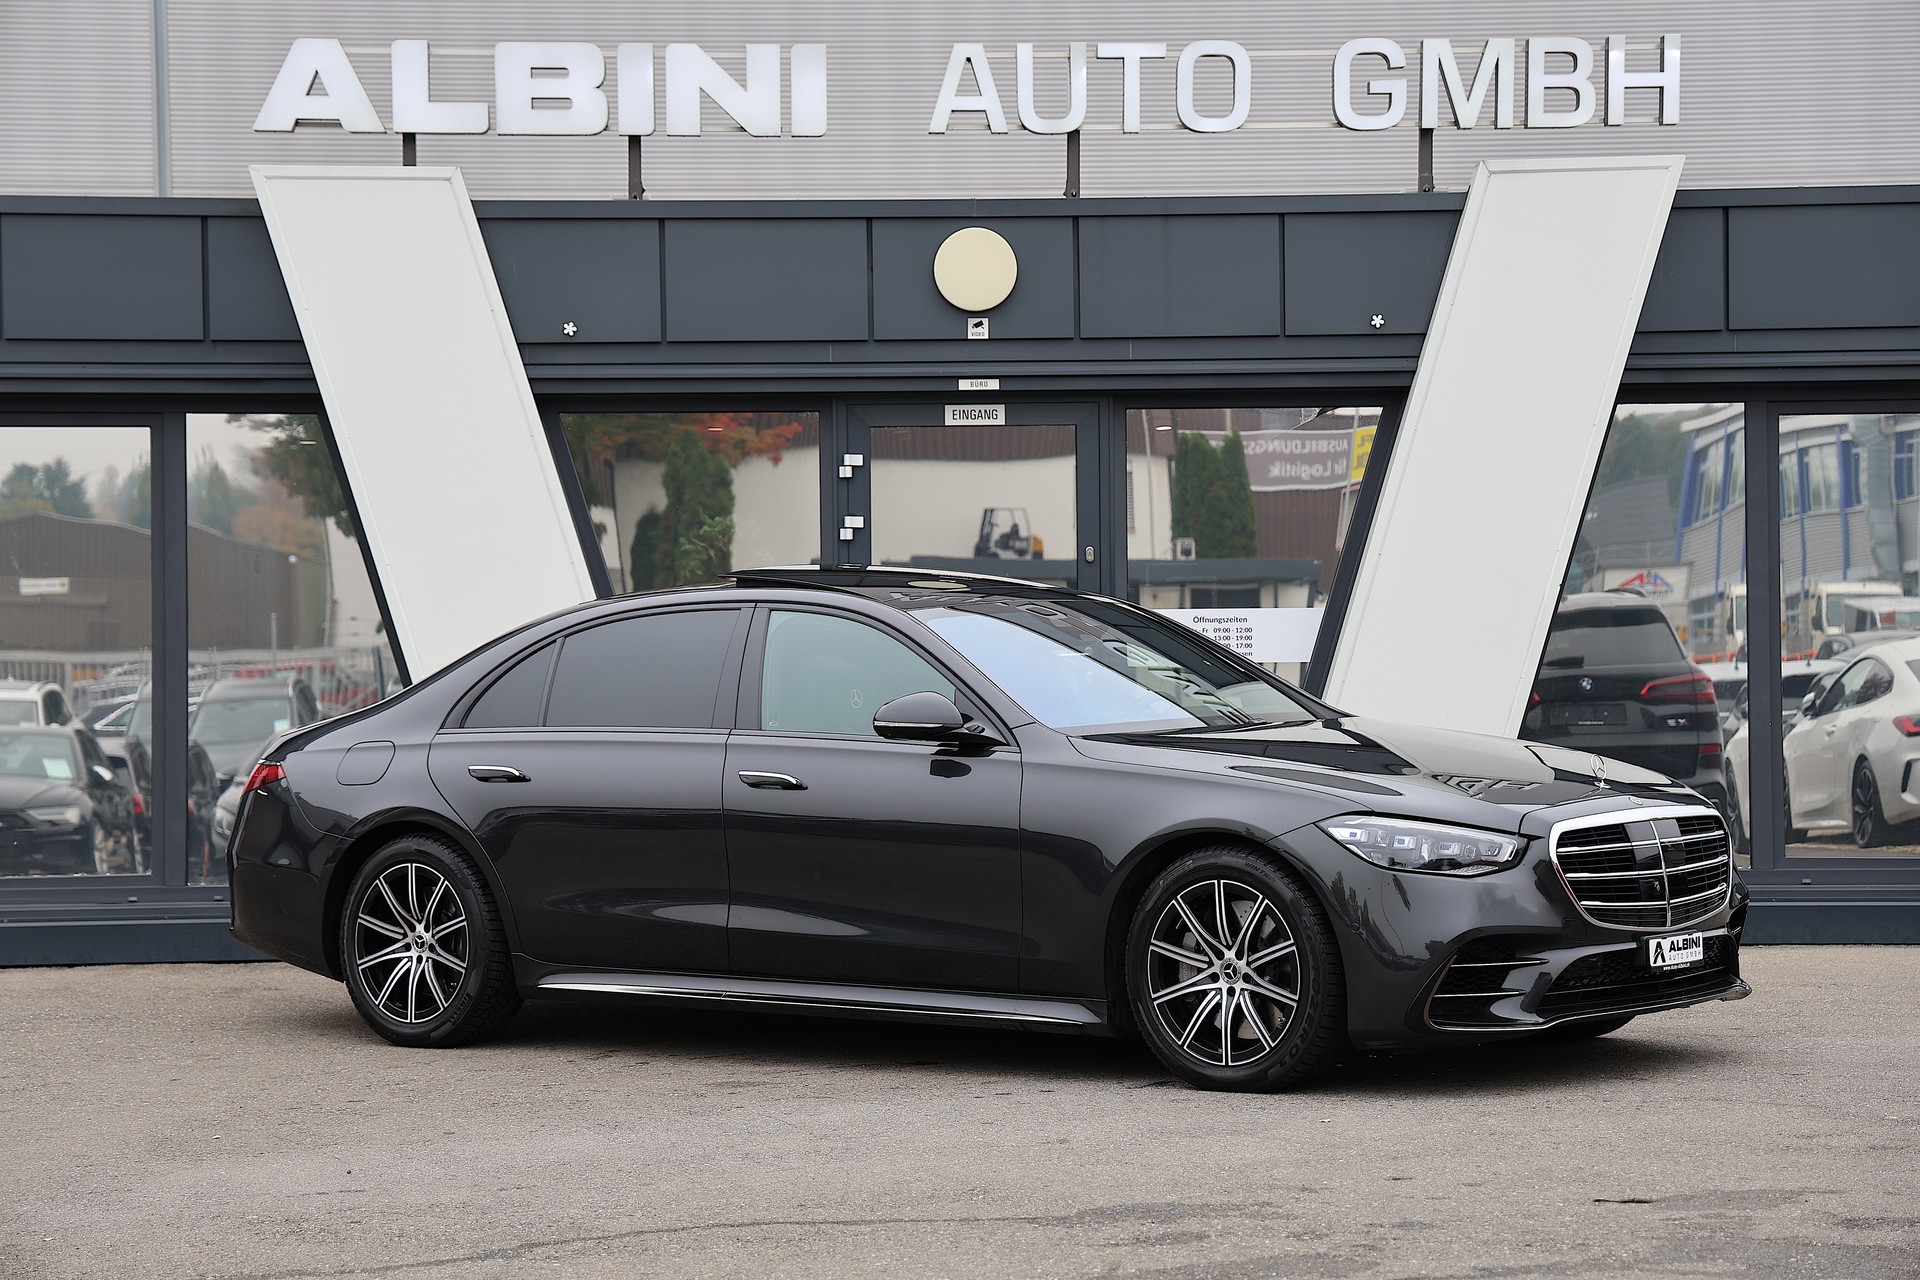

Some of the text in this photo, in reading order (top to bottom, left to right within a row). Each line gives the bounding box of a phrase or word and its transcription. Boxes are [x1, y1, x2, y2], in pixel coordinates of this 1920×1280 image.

[252, 33, 1682, 137] ALBINI AUTO GMBH
[970, 380, 989, 388] BÜRO
[952, 408, 998, 421] EINGANG
[1192, 616, 1248, 624] Öffnungszeiten
[1669, 936, 1700, 952] ALBINI
[1669, 950, 1701, 961] AUTO GMBH
